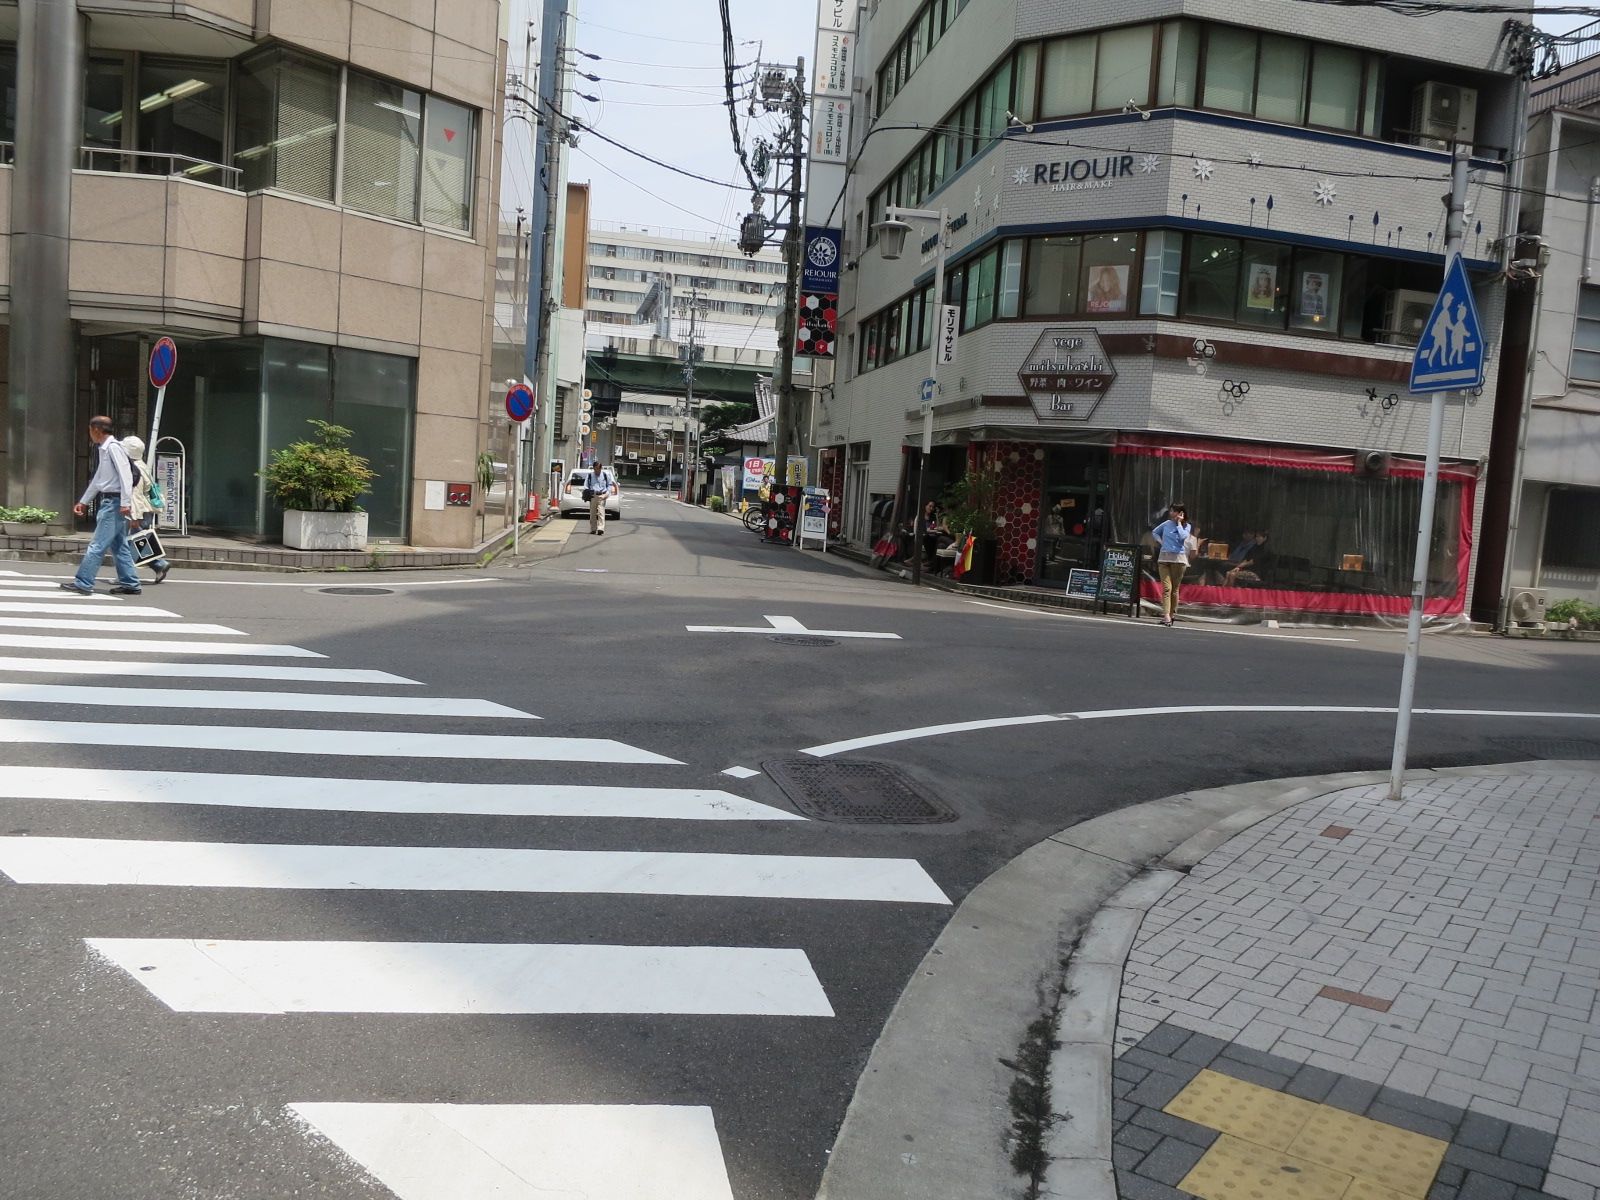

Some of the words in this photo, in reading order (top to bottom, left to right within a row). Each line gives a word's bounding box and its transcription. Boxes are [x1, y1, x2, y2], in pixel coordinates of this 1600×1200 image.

[1034, 155, 1134, 185] REJOUIR
[1051, 179, 1114, 193] HAIR&MAKE
[804, 268, 837, 279] REJOUIR
[944, 309, 956, 362] モリマサビル
[1052, 337, 1083, 349] vege
[1050, 393, 1073, 411] Bar
